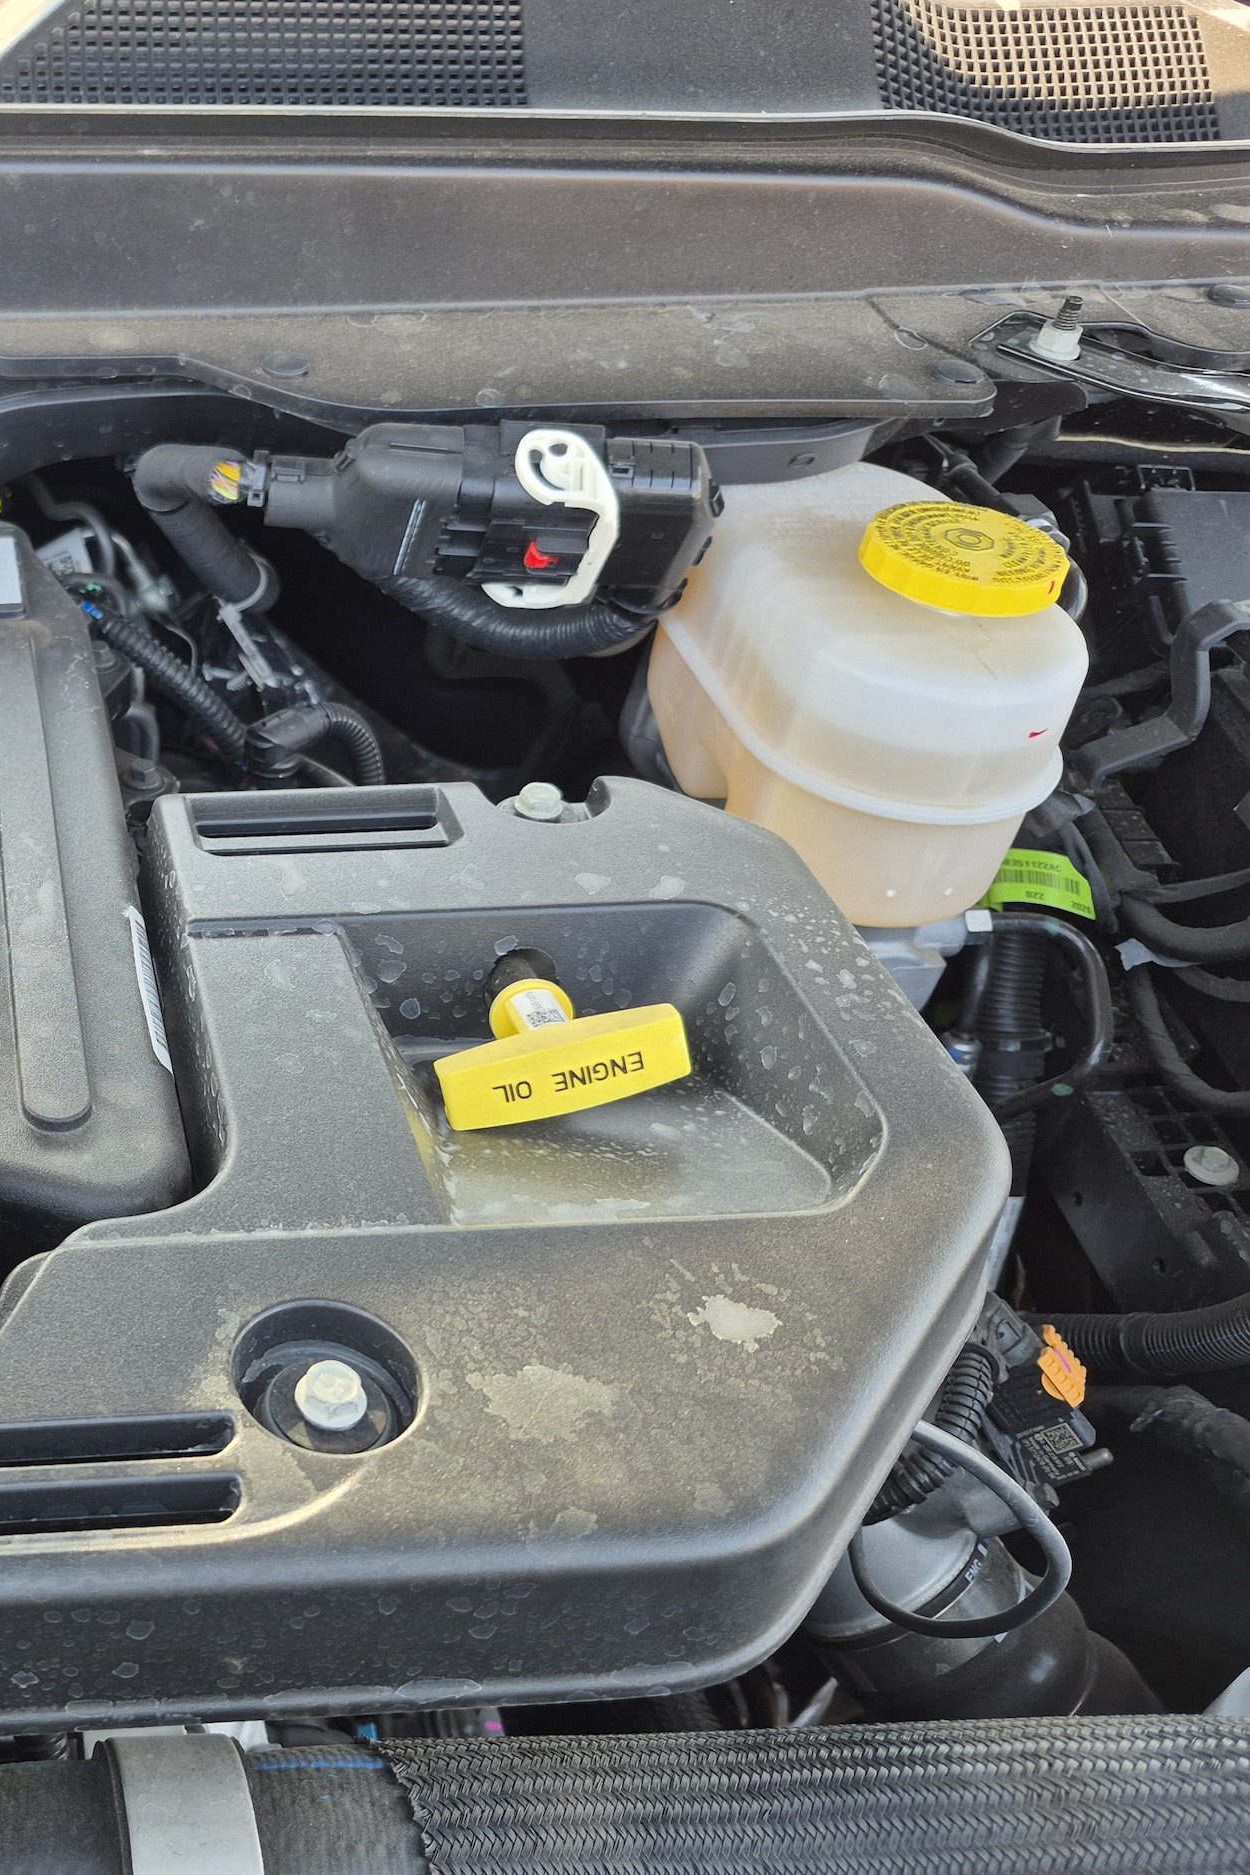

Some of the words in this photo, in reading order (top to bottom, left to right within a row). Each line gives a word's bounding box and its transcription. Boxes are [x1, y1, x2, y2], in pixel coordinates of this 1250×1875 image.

[552, 1051, 645, 1093] ENGINE
[493, 1080, 532, 1103] OIL
[965, 1559, 982, 1582] ENG
